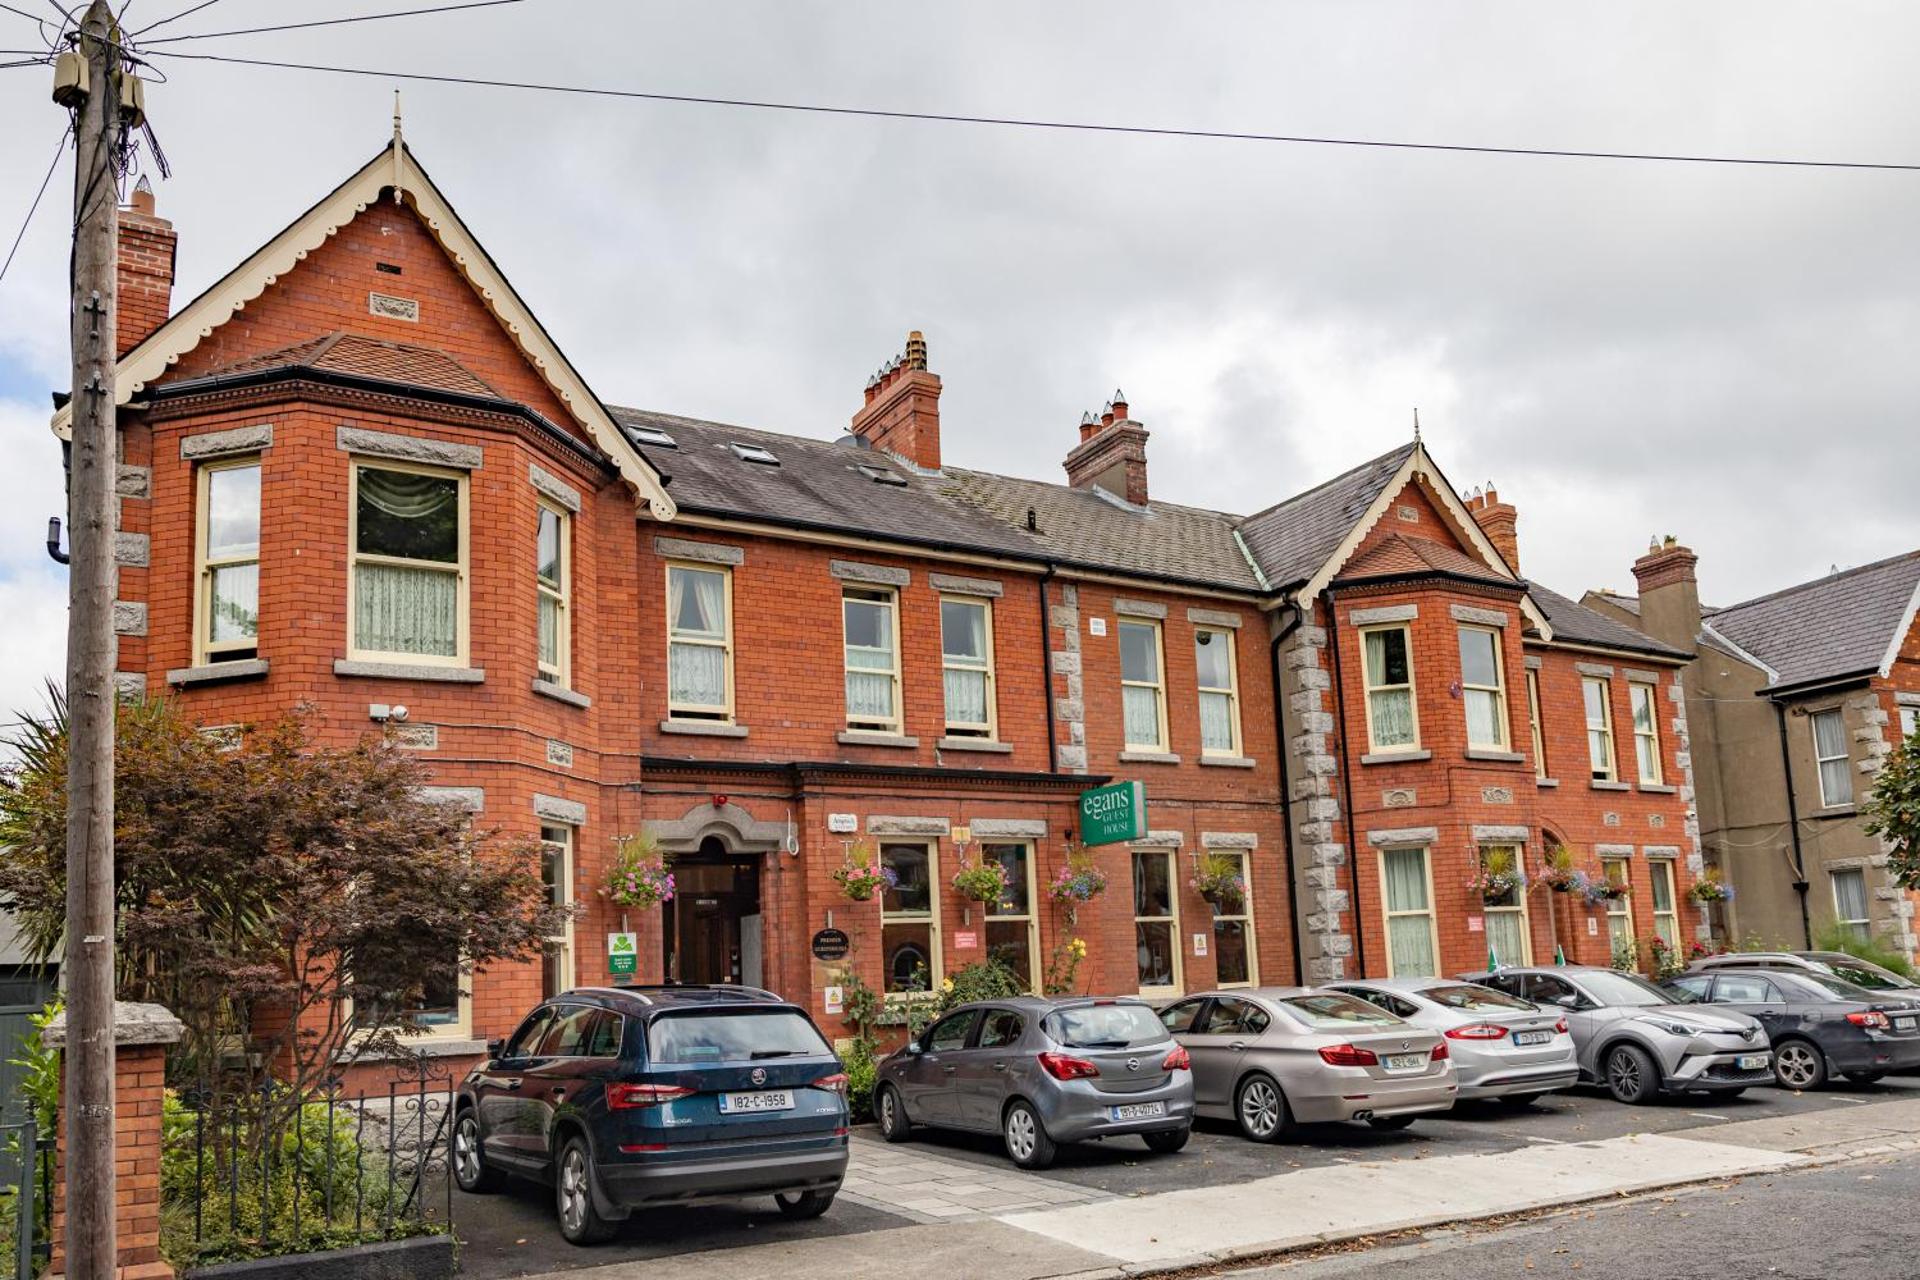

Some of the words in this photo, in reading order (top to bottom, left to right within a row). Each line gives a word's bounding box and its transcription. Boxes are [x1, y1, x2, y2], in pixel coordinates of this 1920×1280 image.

[1084, 789, 1129, 820] egans
[1102, 808, 1129, 822] GUEST
[1104, 821, 1129, 836] HOUSE
